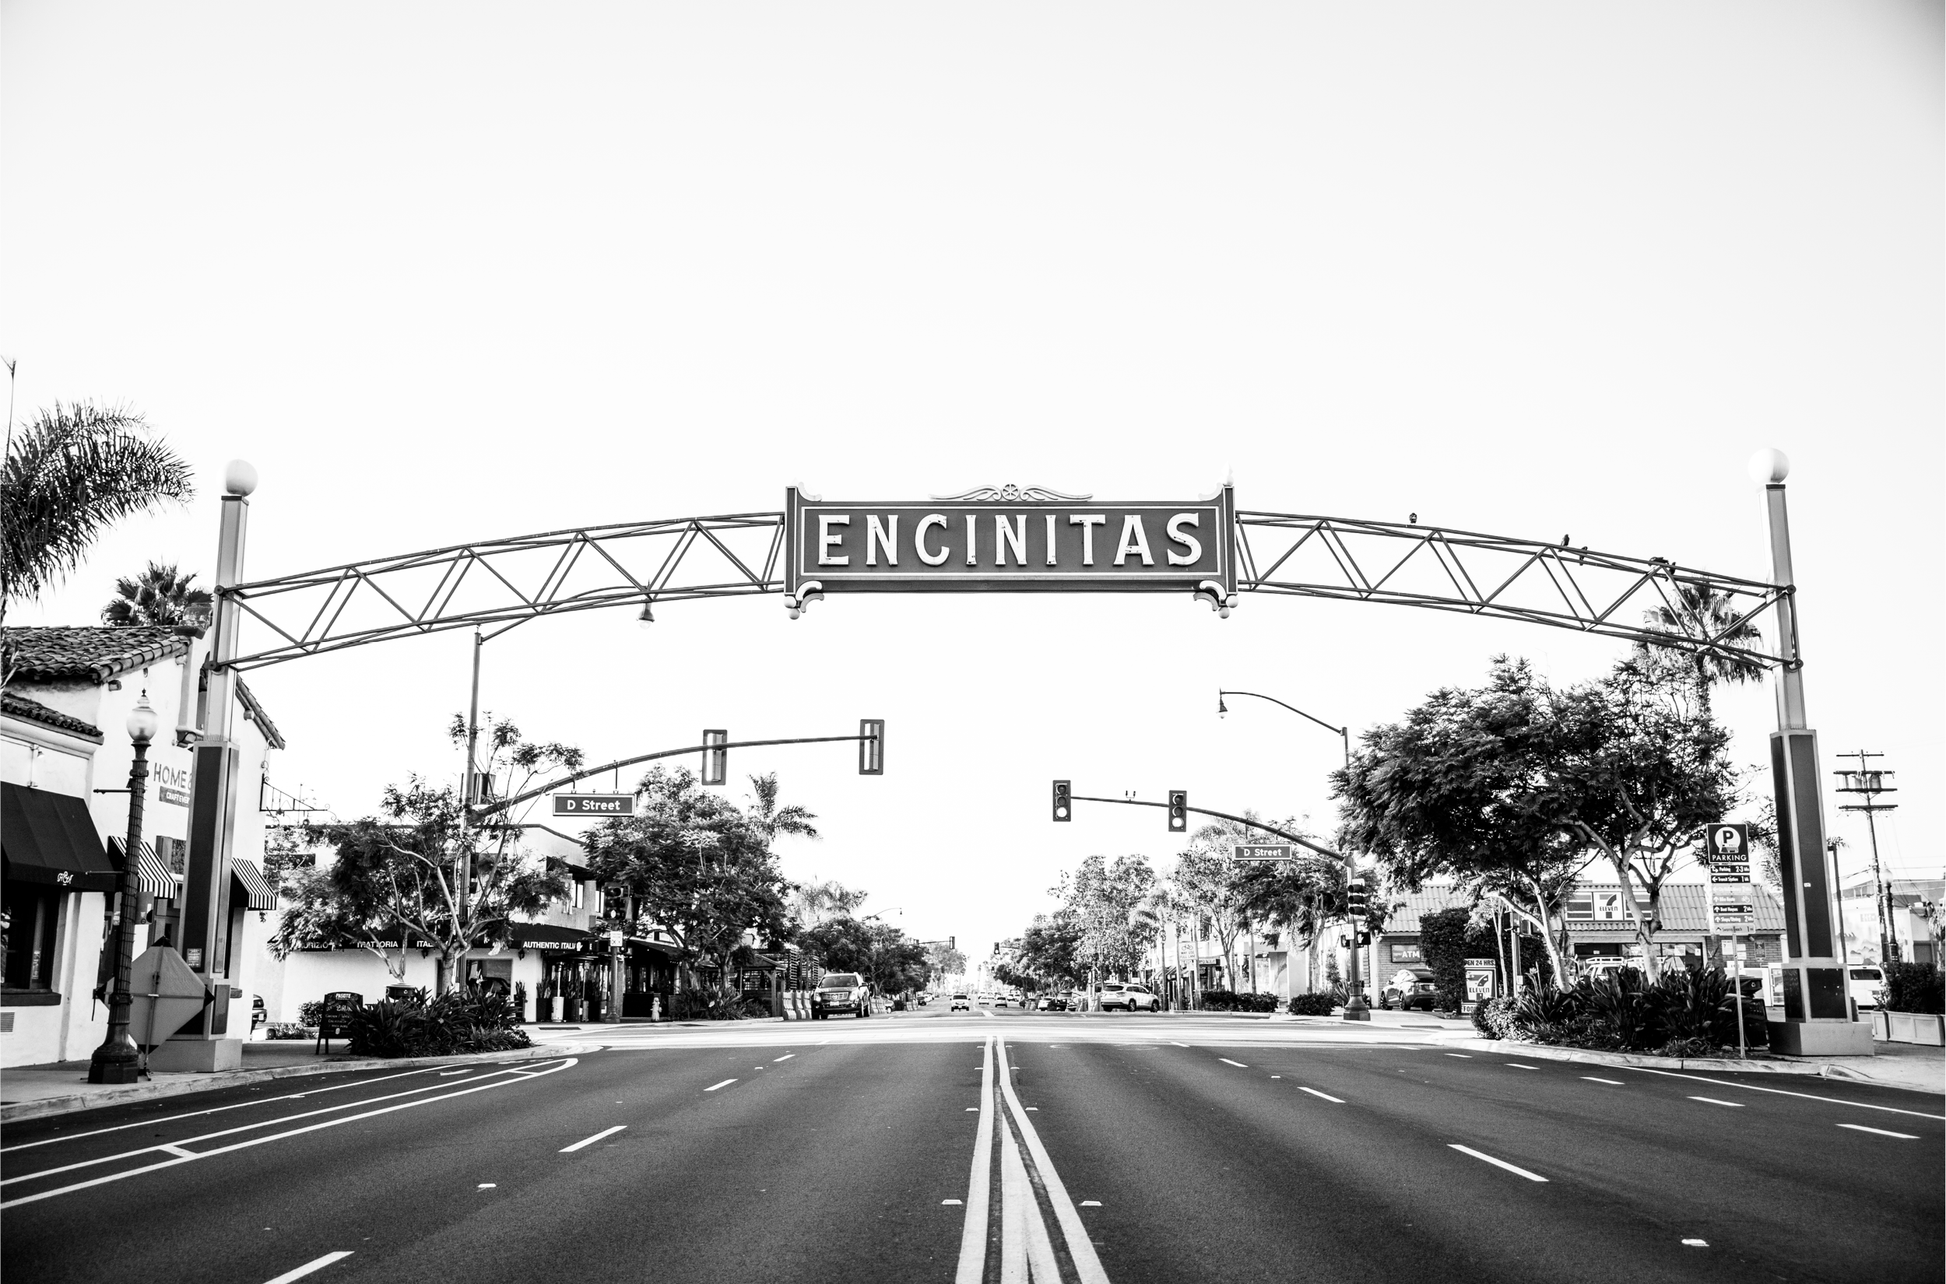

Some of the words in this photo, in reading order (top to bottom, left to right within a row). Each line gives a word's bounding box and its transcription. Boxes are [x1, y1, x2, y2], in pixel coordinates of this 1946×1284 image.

[818, 512, 1202, 567] ENCINITAS
[153, 762, 187, 789] HOME
[567, 799, 576, 810] D
[582, 799, 621, 811] Street
[1722, 830, 1734, 844] P
[1244, 848, 1251, 857] D
[1254, 848, 1282, 857] Street
[523, 941, 560, 949] AUTHENTIC
[1402, 950, 1420, 958] ATM
